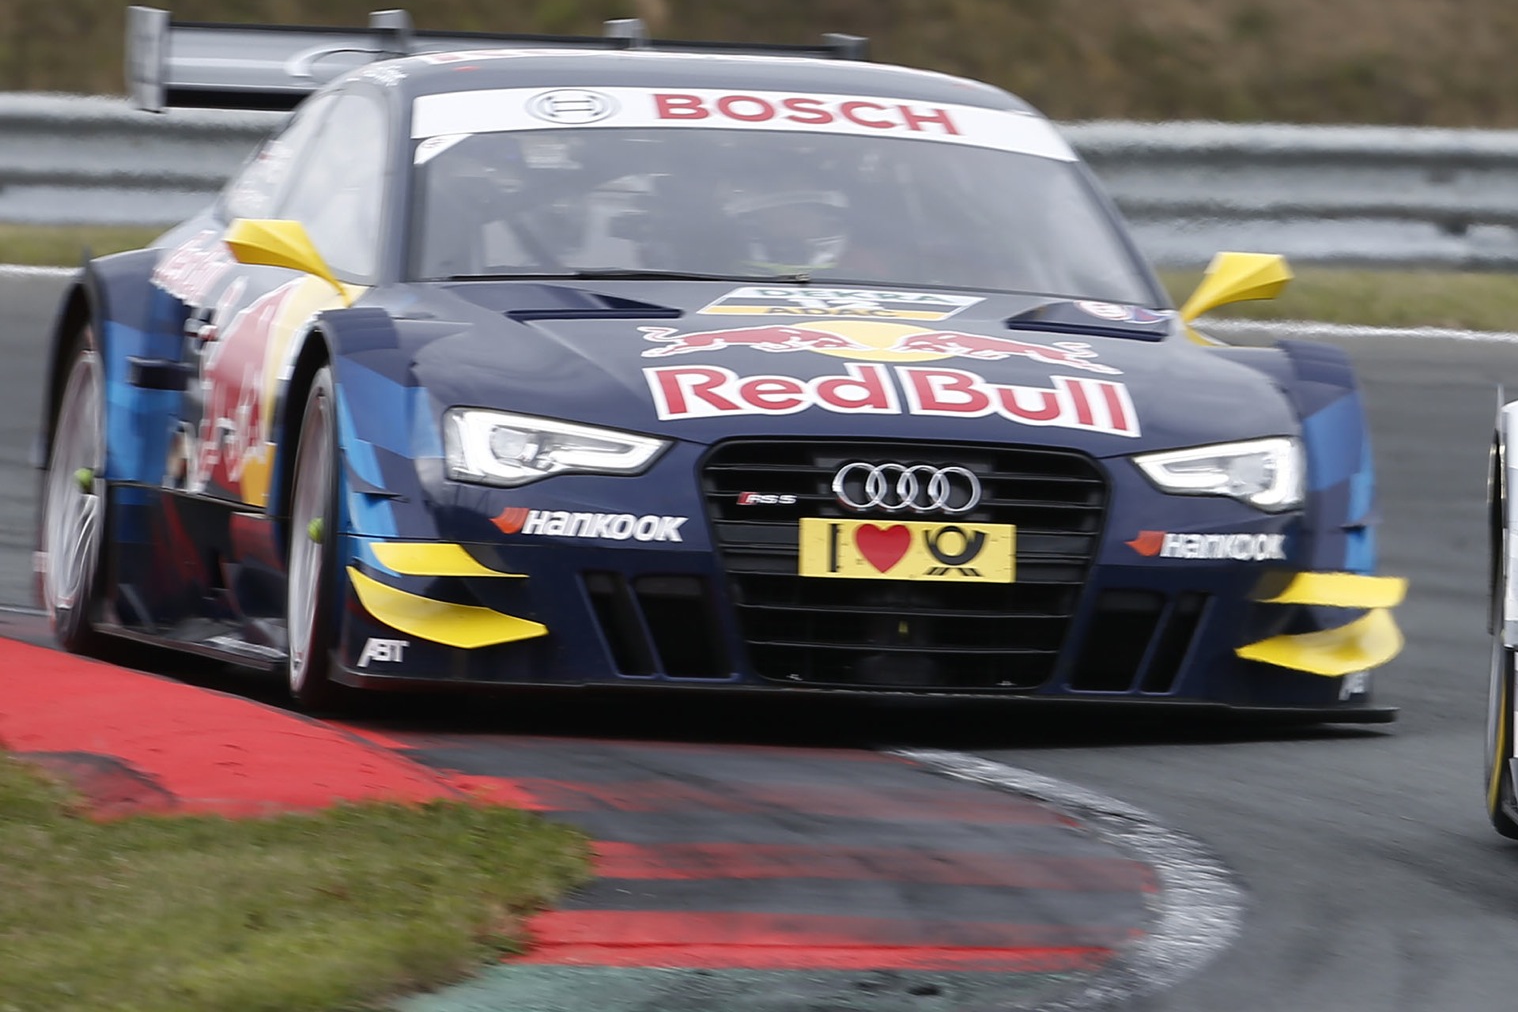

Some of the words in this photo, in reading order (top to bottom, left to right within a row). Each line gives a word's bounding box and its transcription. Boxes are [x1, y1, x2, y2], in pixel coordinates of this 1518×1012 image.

[652, 93, 961, 136] BOSCH
[755, 289, 956, 304] DEKRA
[765, 307, 898, 318] ADAC
[647, 363, 896, 418] Red
[899, 367, 1133, 435] Bull
[356, 637, 410, 668] ABT
